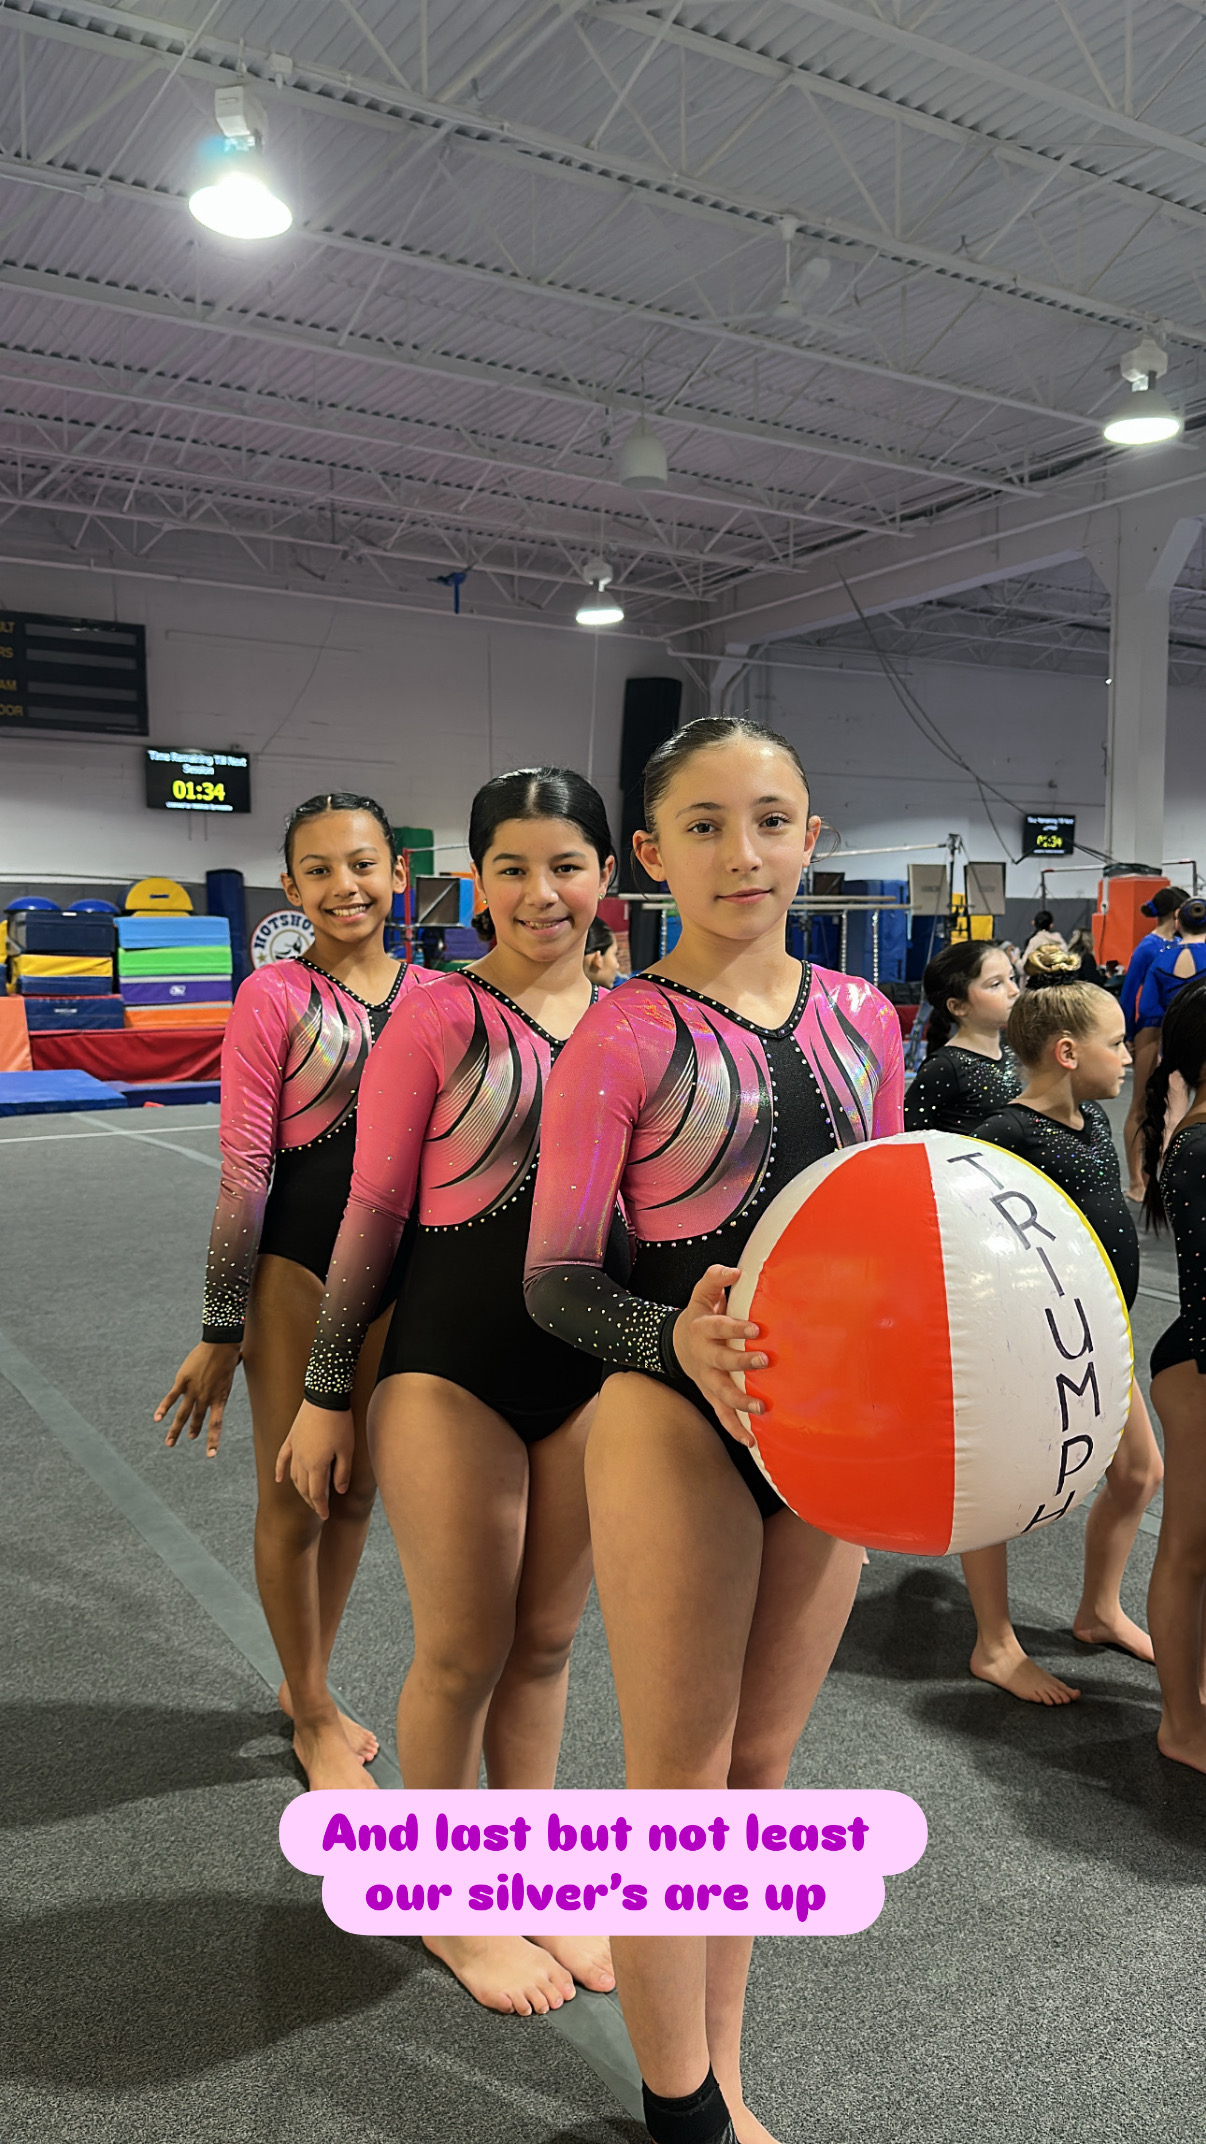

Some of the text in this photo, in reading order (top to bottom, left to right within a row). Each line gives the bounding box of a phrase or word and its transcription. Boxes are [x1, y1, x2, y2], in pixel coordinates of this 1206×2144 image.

[172, 780, 226, 801] 01:34
[254, 914, 315, 949] HOTSHO
[947, 1152, 1102, 1535] TRIUMPH
